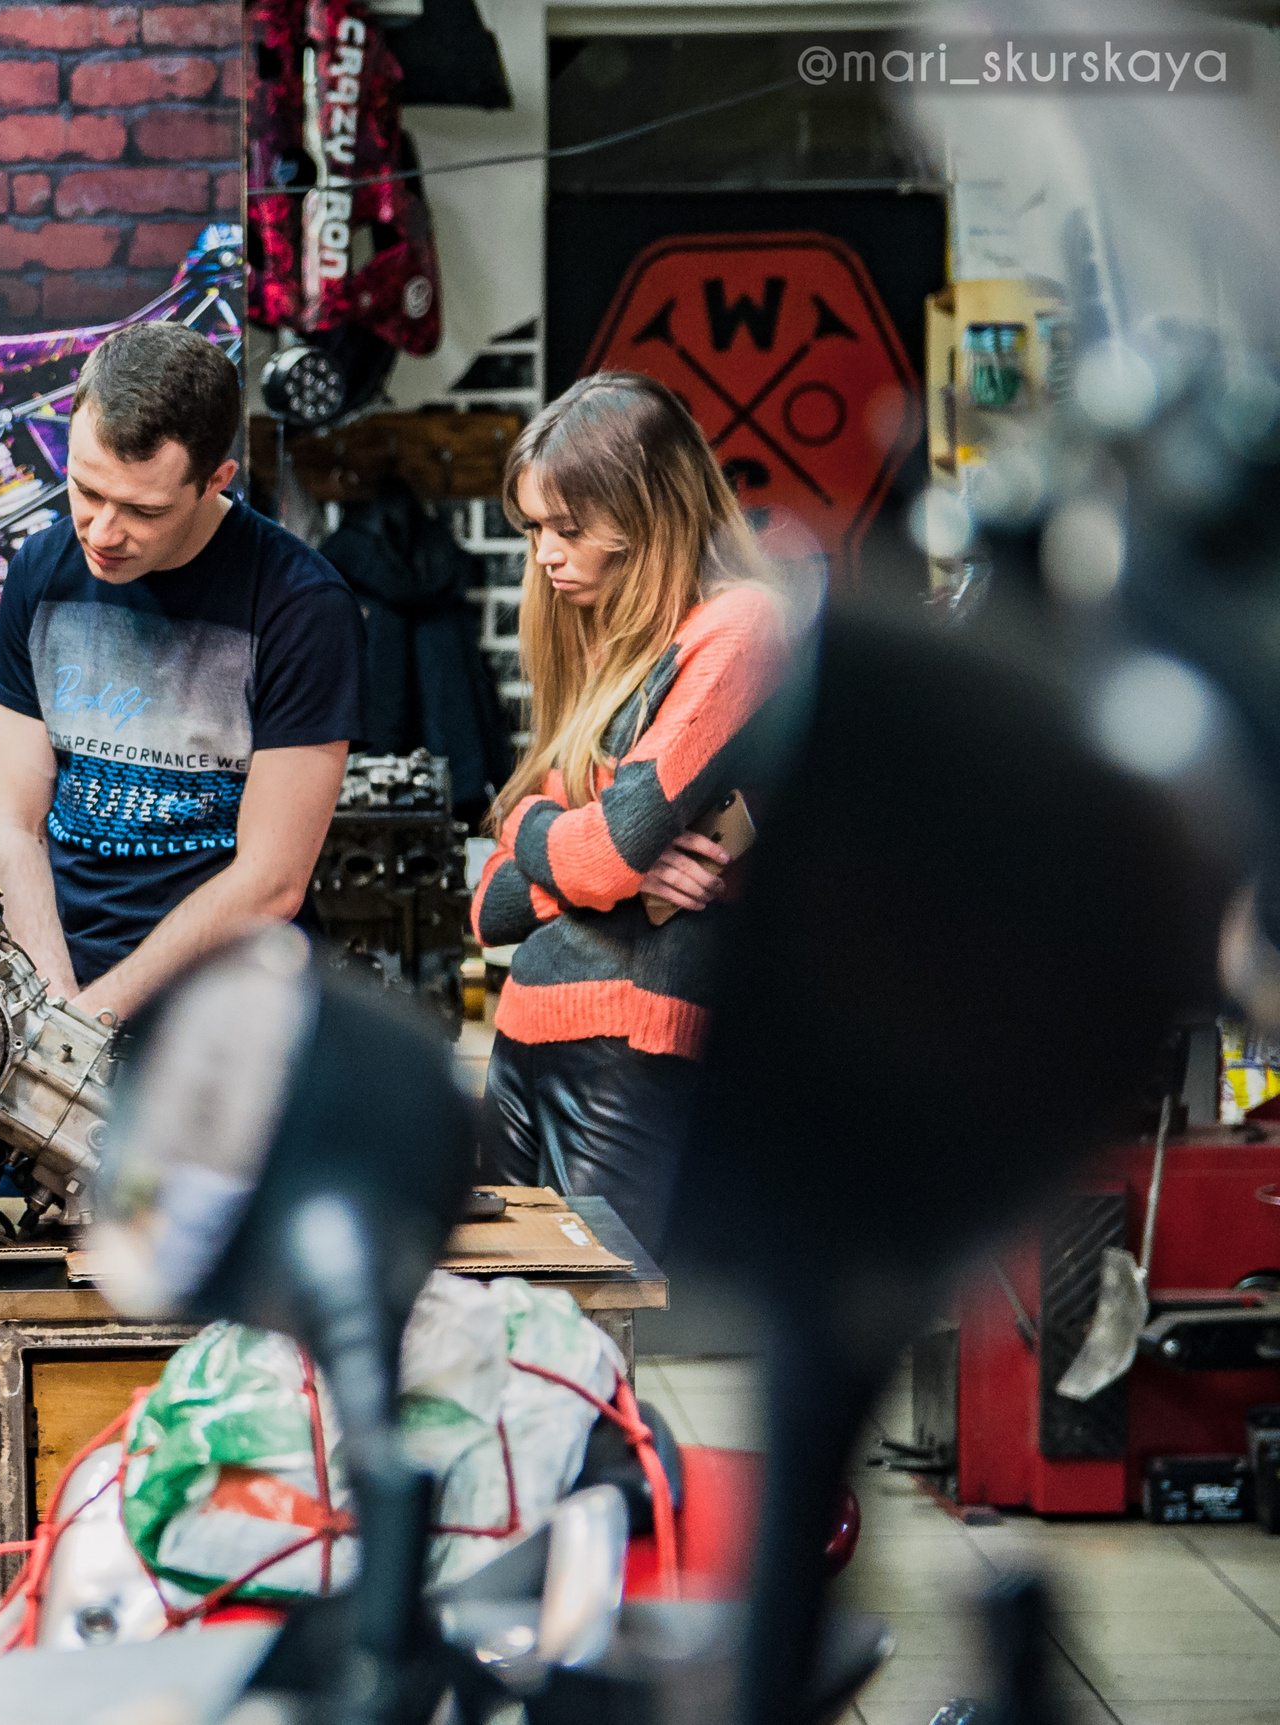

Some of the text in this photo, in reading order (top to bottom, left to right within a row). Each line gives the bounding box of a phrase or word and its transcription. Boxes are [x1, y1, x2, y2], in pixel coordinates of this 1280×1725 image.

[320, 16, 366, 280] CRAZY IRON
[702, 275, 787, 353] W
[75, 735, 209, 770] PERFORMANCE
